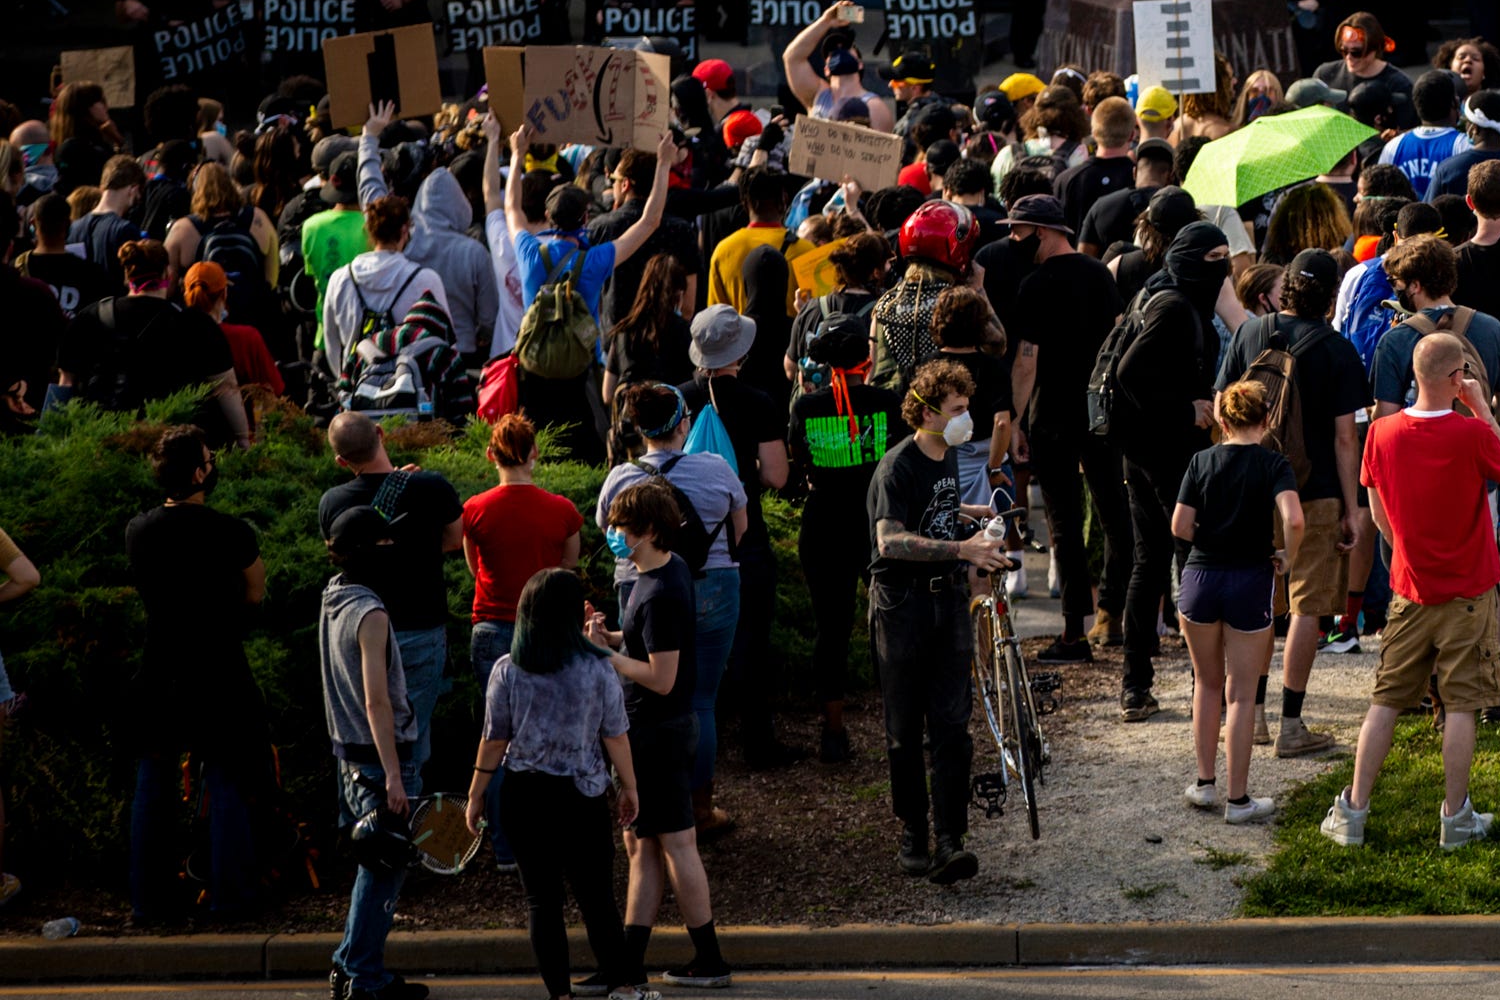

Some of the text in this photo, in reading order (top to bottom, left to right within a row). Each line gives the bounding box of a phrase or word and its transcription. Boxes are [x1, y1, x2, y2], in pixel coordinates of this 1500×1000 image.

[605, 6, 696, 33] POLICE
[750, 0, 823, 26] OLICE
[154, 3, 241, 53] POLICE
[264, 24, 357, 53] OLICE
[800, 123, 819, 136] WHO
